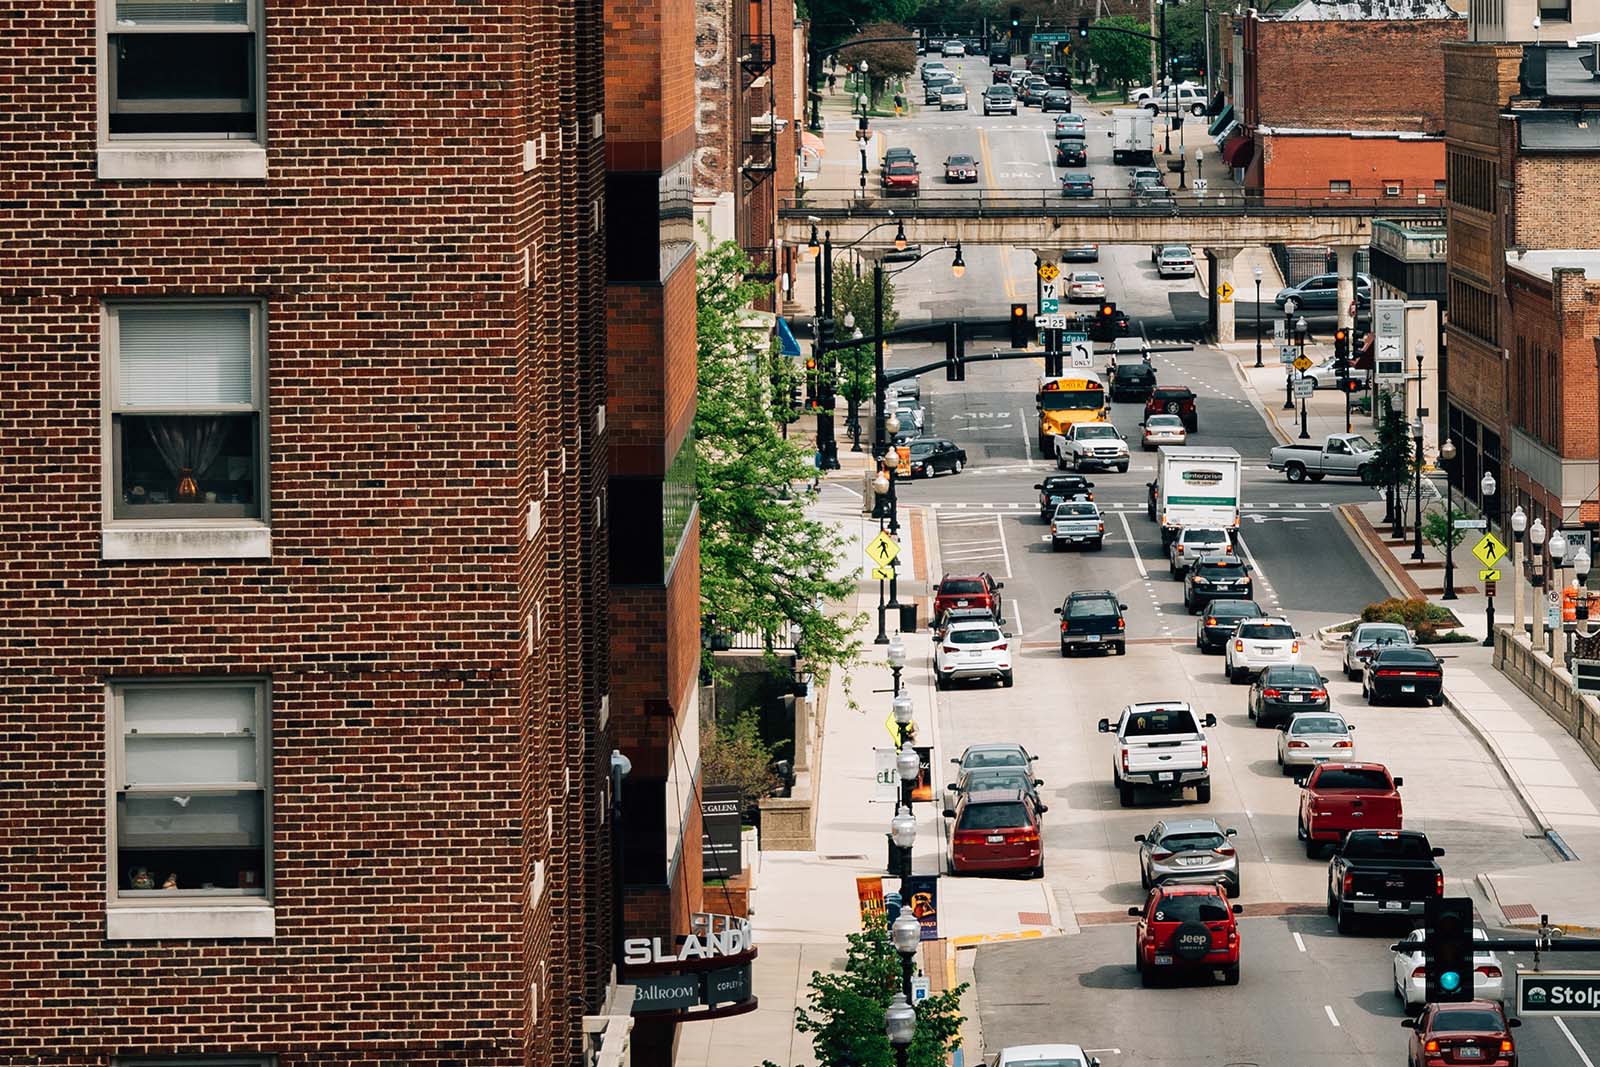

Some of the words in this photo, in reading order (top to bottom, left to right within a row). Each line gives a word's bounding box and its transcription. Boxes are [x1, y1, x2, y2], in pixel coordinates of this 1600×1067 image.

[1052, 319, 1064, 328] 25
[1184, 472, 1222, 480] enterprise
[707, 804, 737, 812] GALENA
[1180, 934, 1207, 945] Jeep
